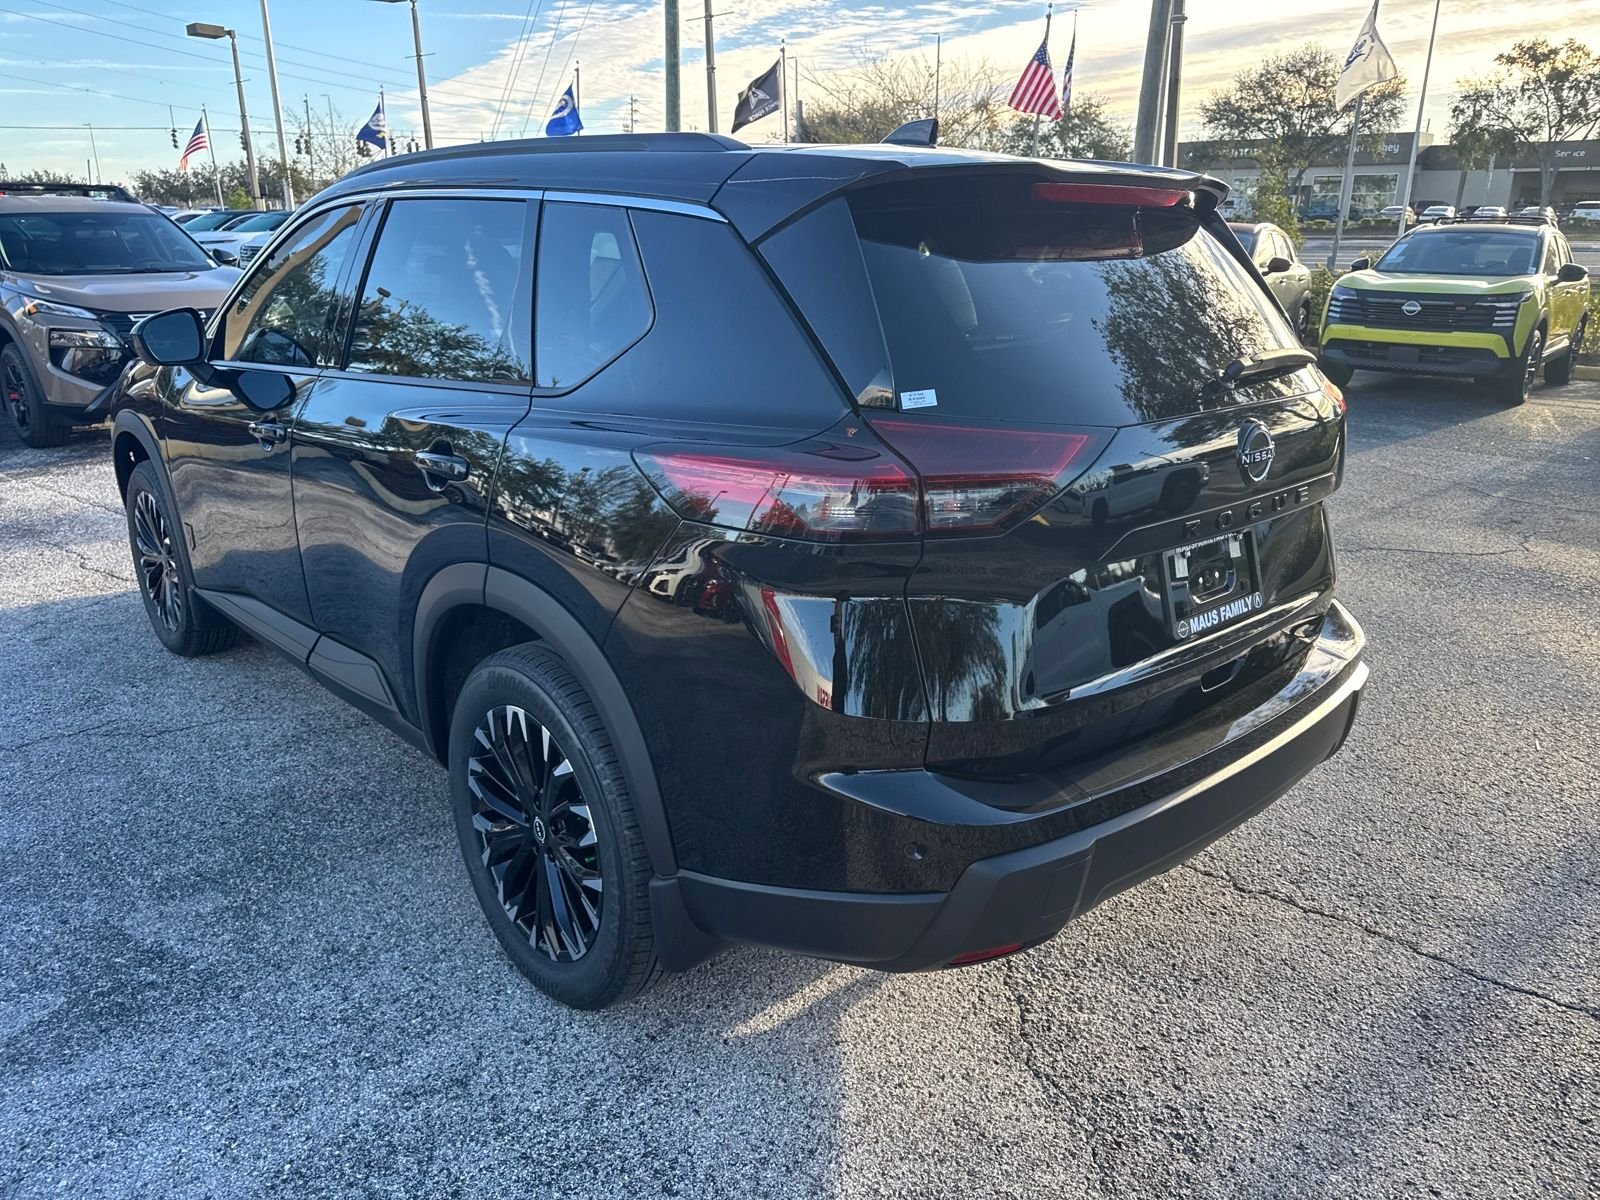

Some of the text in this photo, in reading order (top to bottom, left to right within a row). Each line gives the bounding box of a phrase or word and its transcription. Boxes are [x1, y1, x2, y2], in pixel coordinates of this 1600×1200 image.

[1555, 149, 1586, 158] Serice
[1184, 486, 1309, 540] ROGUE
[1189, 595, 1253, 634] MAUS FAMILY
